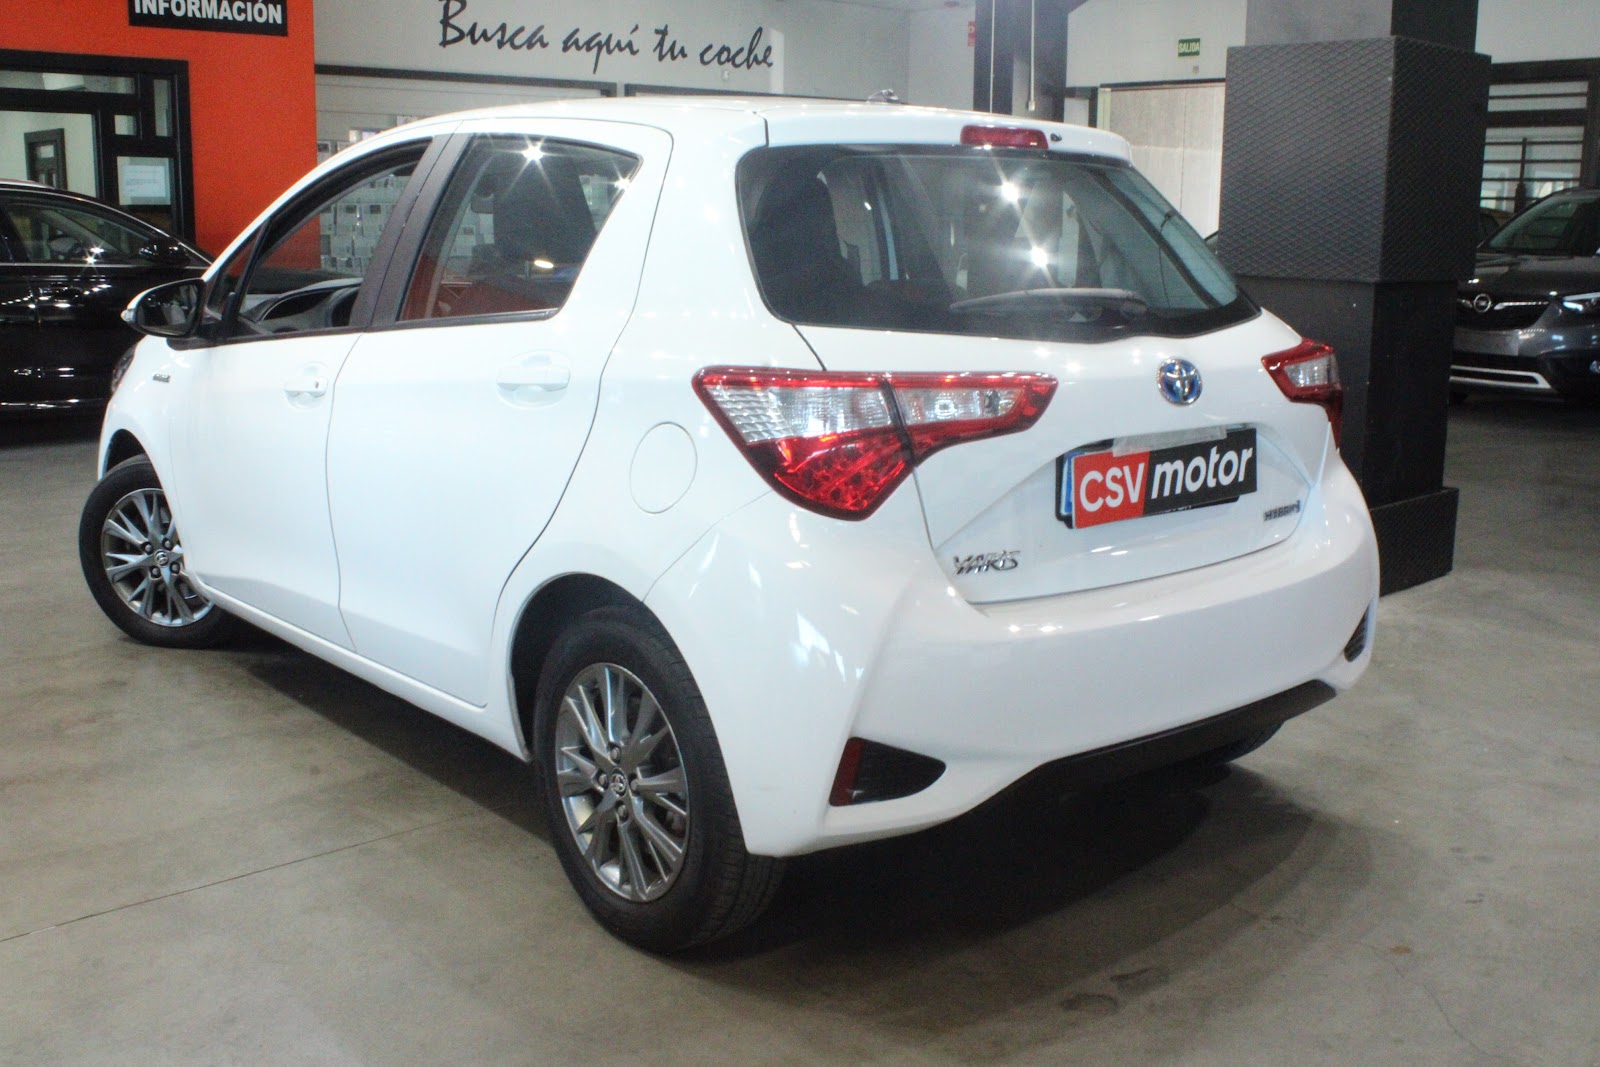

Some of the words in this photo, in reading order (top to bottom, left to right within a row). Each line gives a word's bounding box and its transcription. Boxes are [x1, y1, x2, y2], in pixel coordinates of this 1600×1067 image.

[134, 0, 282, 24] INFORMACIÓN
[440, 0, 549, 50] Busca
[562, 24, 640, 74] aquí
[654, 24, 688, 61] tu
[699, 26, 773, 70] coche
[1178, 42, 1200, 53] SALIDA
[1079, 462, 1146, 513] CSV
[1150, 445, 1254, 500] motor
